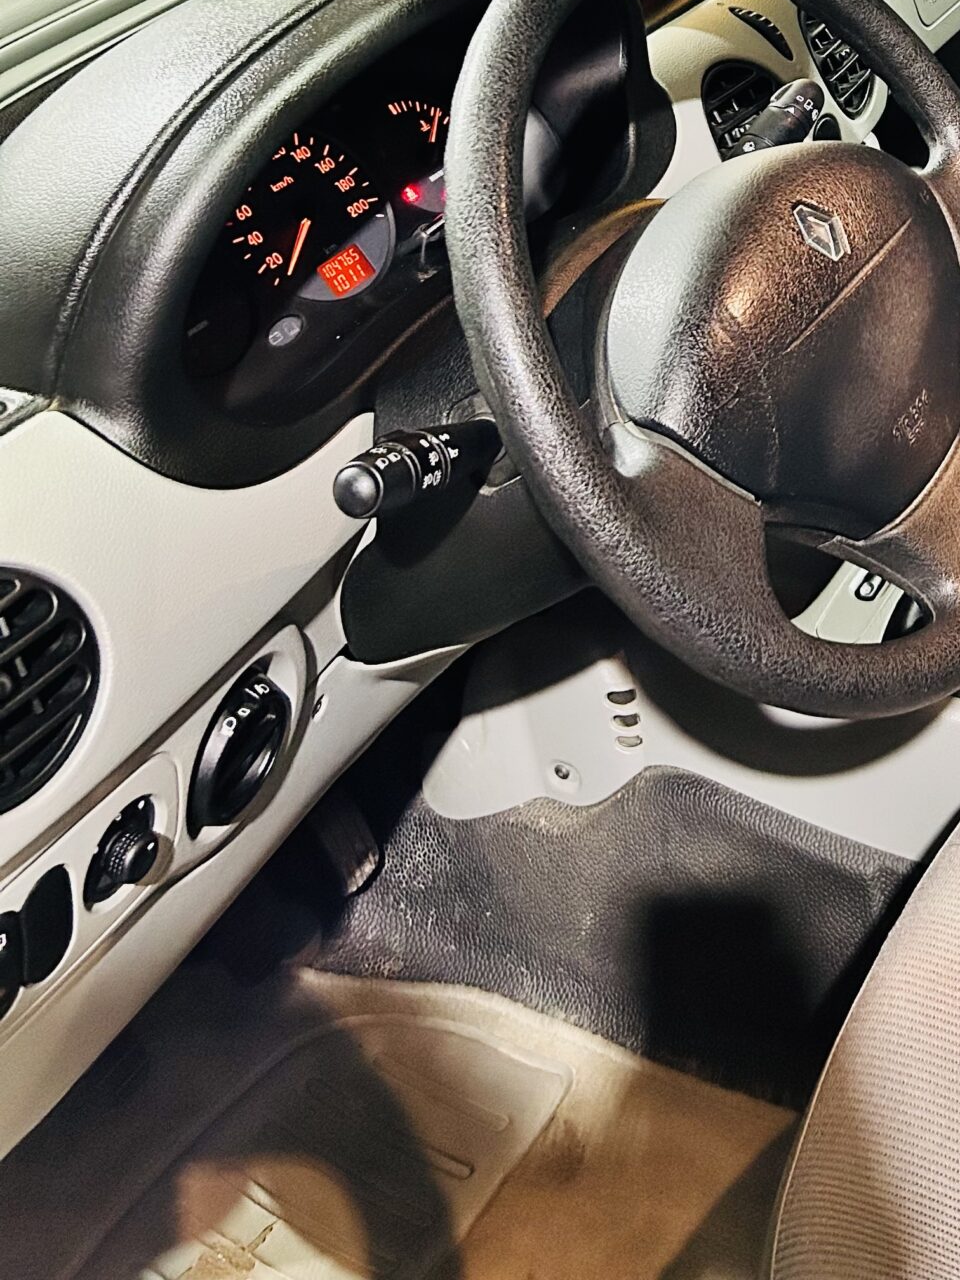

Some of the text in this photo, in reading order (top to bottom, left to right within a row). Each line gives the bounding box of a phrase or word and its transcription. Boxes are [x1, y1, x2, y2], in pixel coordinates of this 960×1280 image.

[290, 146, 311, 163] 140
[314, 157, 336, 174] 160
[270, 176, 294, 193] km/h
[334, 175, 356, 193] 180
[235, 204, 253, 221] 60
[346, 198, 369, 218] 200
[247, 230, 264, 246] 40
[265, 252, 284, 269] 20
[322, 247, 360, 279] 104765
